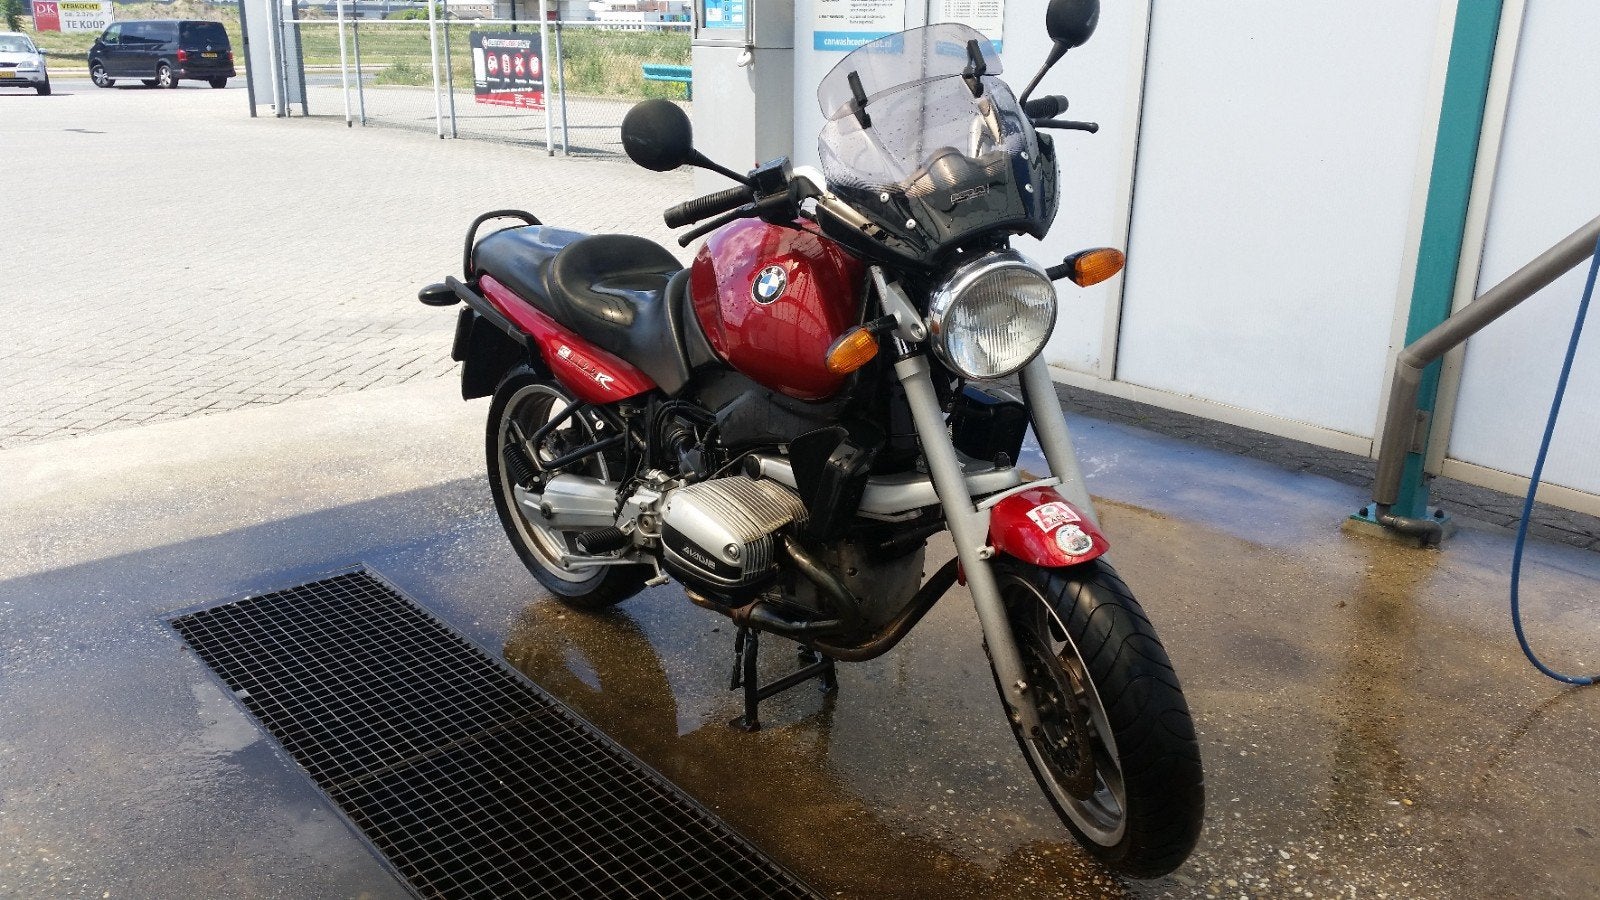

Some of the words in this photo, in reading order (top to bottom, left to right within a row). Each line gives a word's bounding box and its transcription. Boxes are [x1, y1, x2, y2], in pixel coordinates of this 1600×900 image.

[36, 4, 56, 14] DK
[65, 20, 78, 29] TE
[79, 20, 105, 29] KOOP
